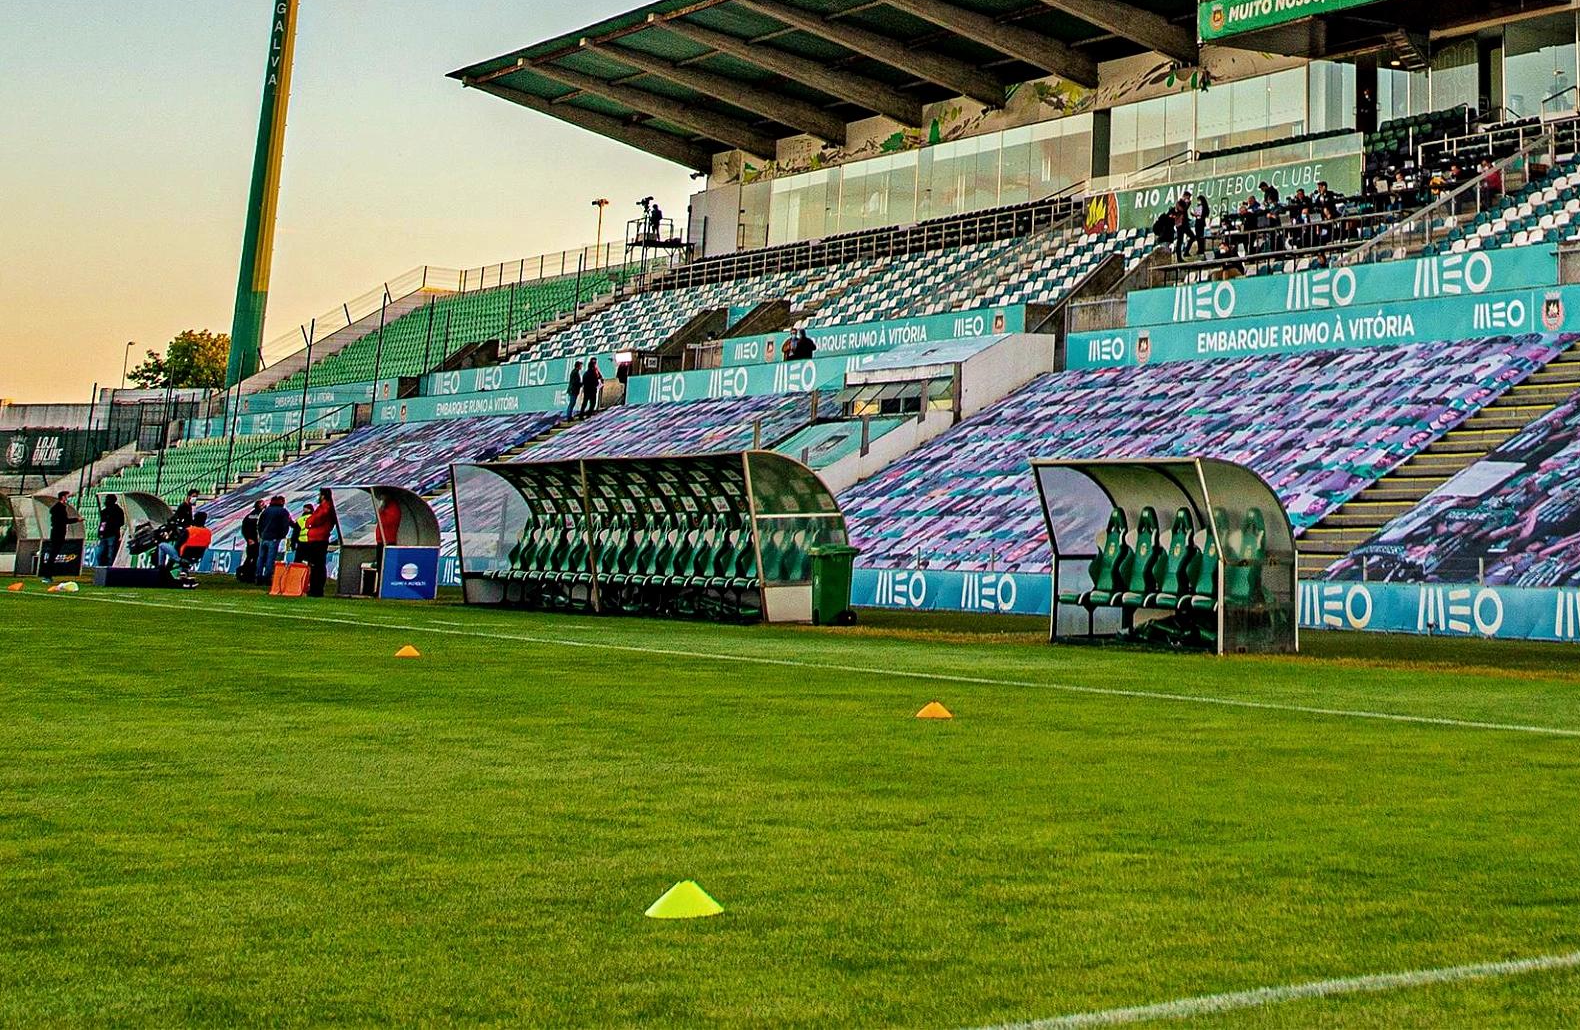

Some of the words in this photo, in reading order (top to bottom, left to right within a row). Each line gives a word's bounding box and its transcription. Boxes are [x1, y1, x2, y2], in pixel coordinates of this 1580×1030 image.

[1135, 188, 1160, 209] RIO
[1165, 183, 1195, 205] AVE
[1197, 173, 1262, 198] FUTEBOL
[1271, 164, 1322, 189] CLUBE
[1286, 267, 1356, 310] MEO
[1413, 251, 1492, 298] MEO
[1173, 281, 1236, 320] MEO
[1474, 299, 1525, 329] MEO
[849, 330, 877, 348] RUMO
[878, 327, 887, 345] À
[888, 321, 927, 344] VITÓRIA
[953, 316, 983, 338] MEO
[1197, 326, 1278, 354] EMBARQUE
[1282, 321, 1329, 346] RUMO
[1333, 314, 1345, 342] À
[1349, 309, 1415, 339] VITÓRIA
[735, 341, 758, 360] MEO
[1088, 337, 1124, 362] MEO
[434, 370, 460, 395] MEO
[475, 366, 502, 391] MEO
[518, 361, 547, 387] MEO
[650, 373, 684, 403] MEO
[708, 368, 748, 398] MEO
[773, 361, 816, 392] MEO
[875, 570, 926, 607] MEO
[961, 573, 1017, 610] MEO
[1298, 583, 1372, 629] MEO
[1417, 586, 1503, 635] MEO
